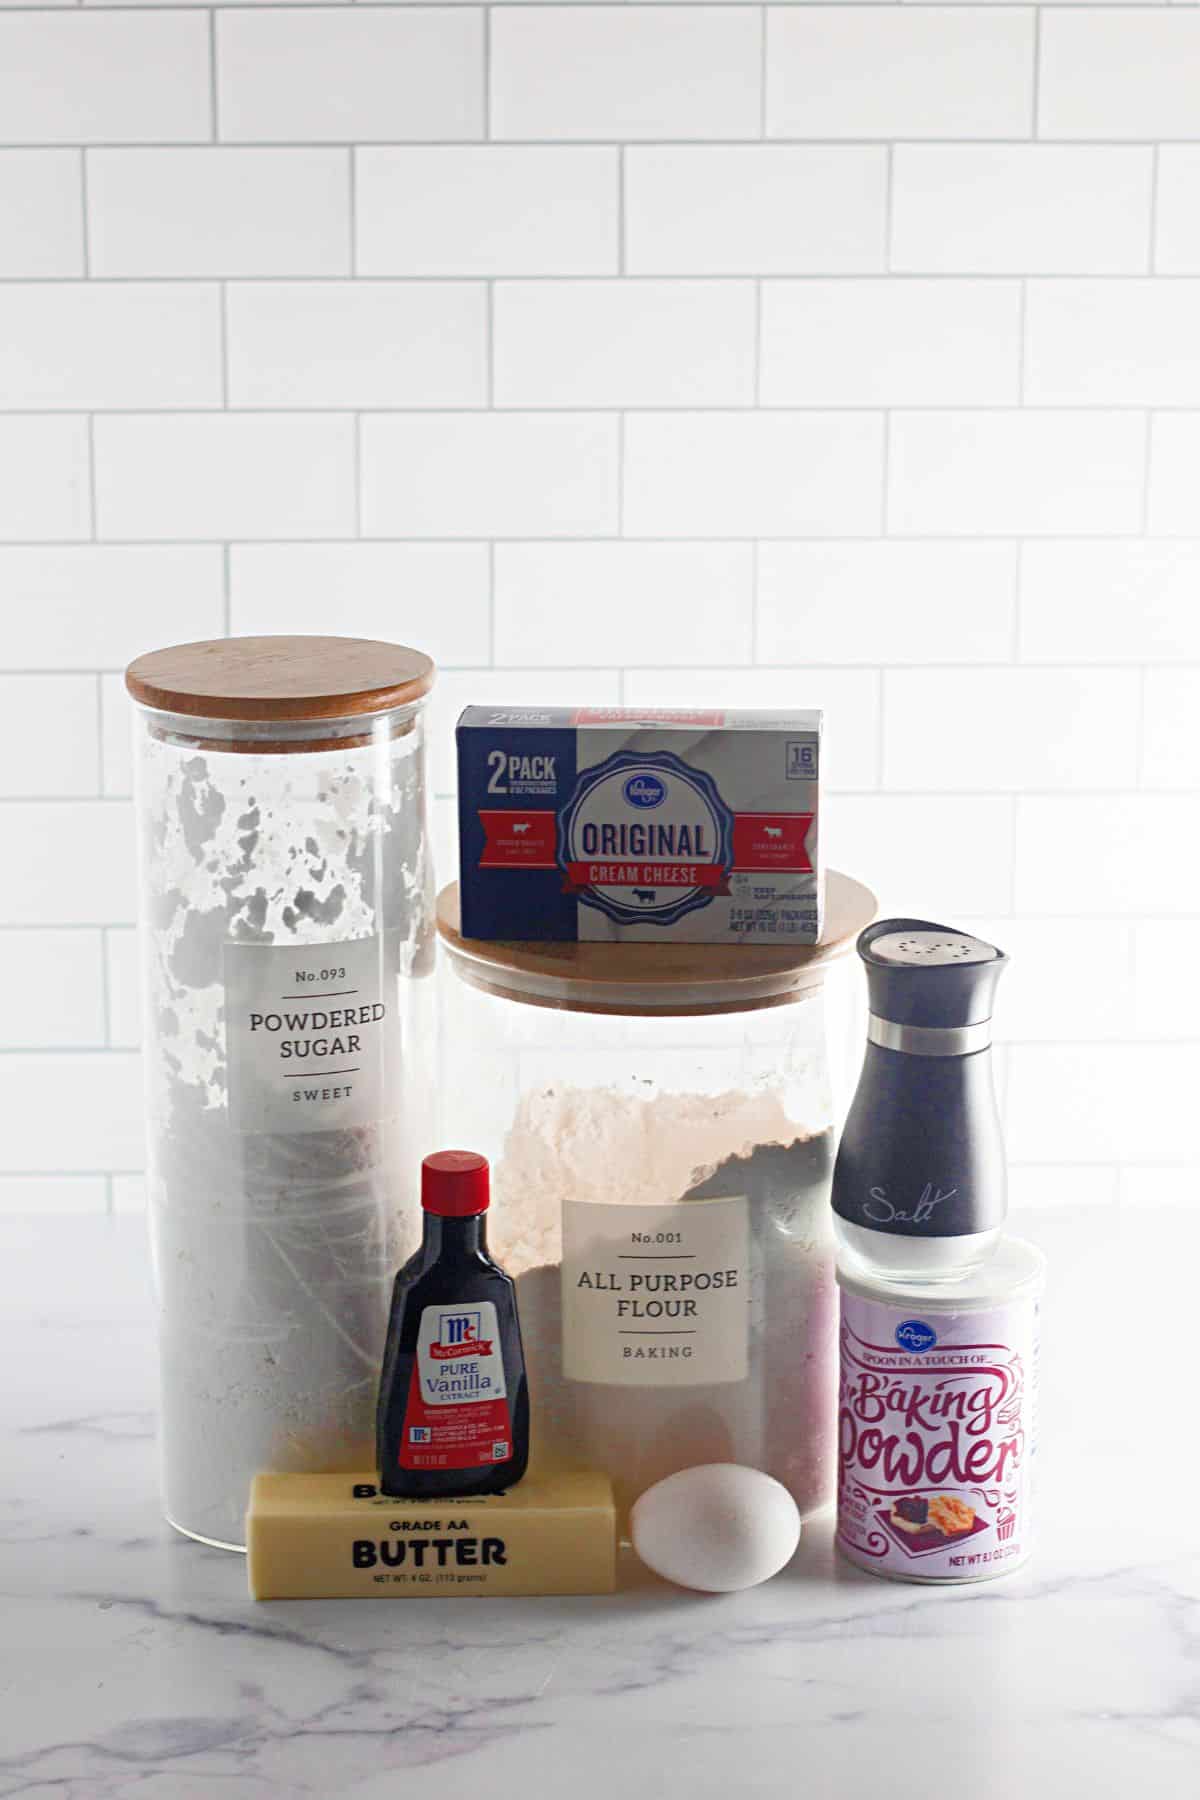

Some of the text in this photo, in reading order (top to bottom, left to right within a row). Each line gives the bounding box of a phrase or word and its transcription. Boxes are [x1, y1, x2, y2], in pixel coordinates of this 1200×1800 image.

[792, 747, 812, 762] 16
[487, 750, 556, 794] 2 PACK
[582, 822, 712, 857] ORIGINAL
[589, 865, 698, 884] CREAM CHEESE
[296, 967, 346, 982] No.093
[250, 1003, 386, 1032] POWDERED
[279, 1035, 361, 1058] SUGAR
[292, 1086, 352, 1102] SWEET
[862, 1182, 958, 1223] Salt
[631, 1232, 682, 1243] No.001
[577, 1270, 738, 1292] ALL PURPOSE
[617, 1299, 698, 1318] FLOUR
[898, 1327, 935, 1347] Kroger
[623, 1347, 693, 1358] BAKING
[863, 1352, 897, 1366] SPOON
[900, 1354, 911, 1366] IN
[912, 1354, 922, 1366] A
[926, 1354, 968, 1365] TOUCH
[440, 1362, 480, 1376] PURE
[426, 1375, 491, 1393] Vanilla
[853, 1372, 1000, 1436] Baking
[838, 1406, 1018, 1487] Powder
[389, 1520, 470, 1532] GRADE AA
[352, 1537, 507, 1569] BUTTER
[949, 1556, 966, 1568] NET
